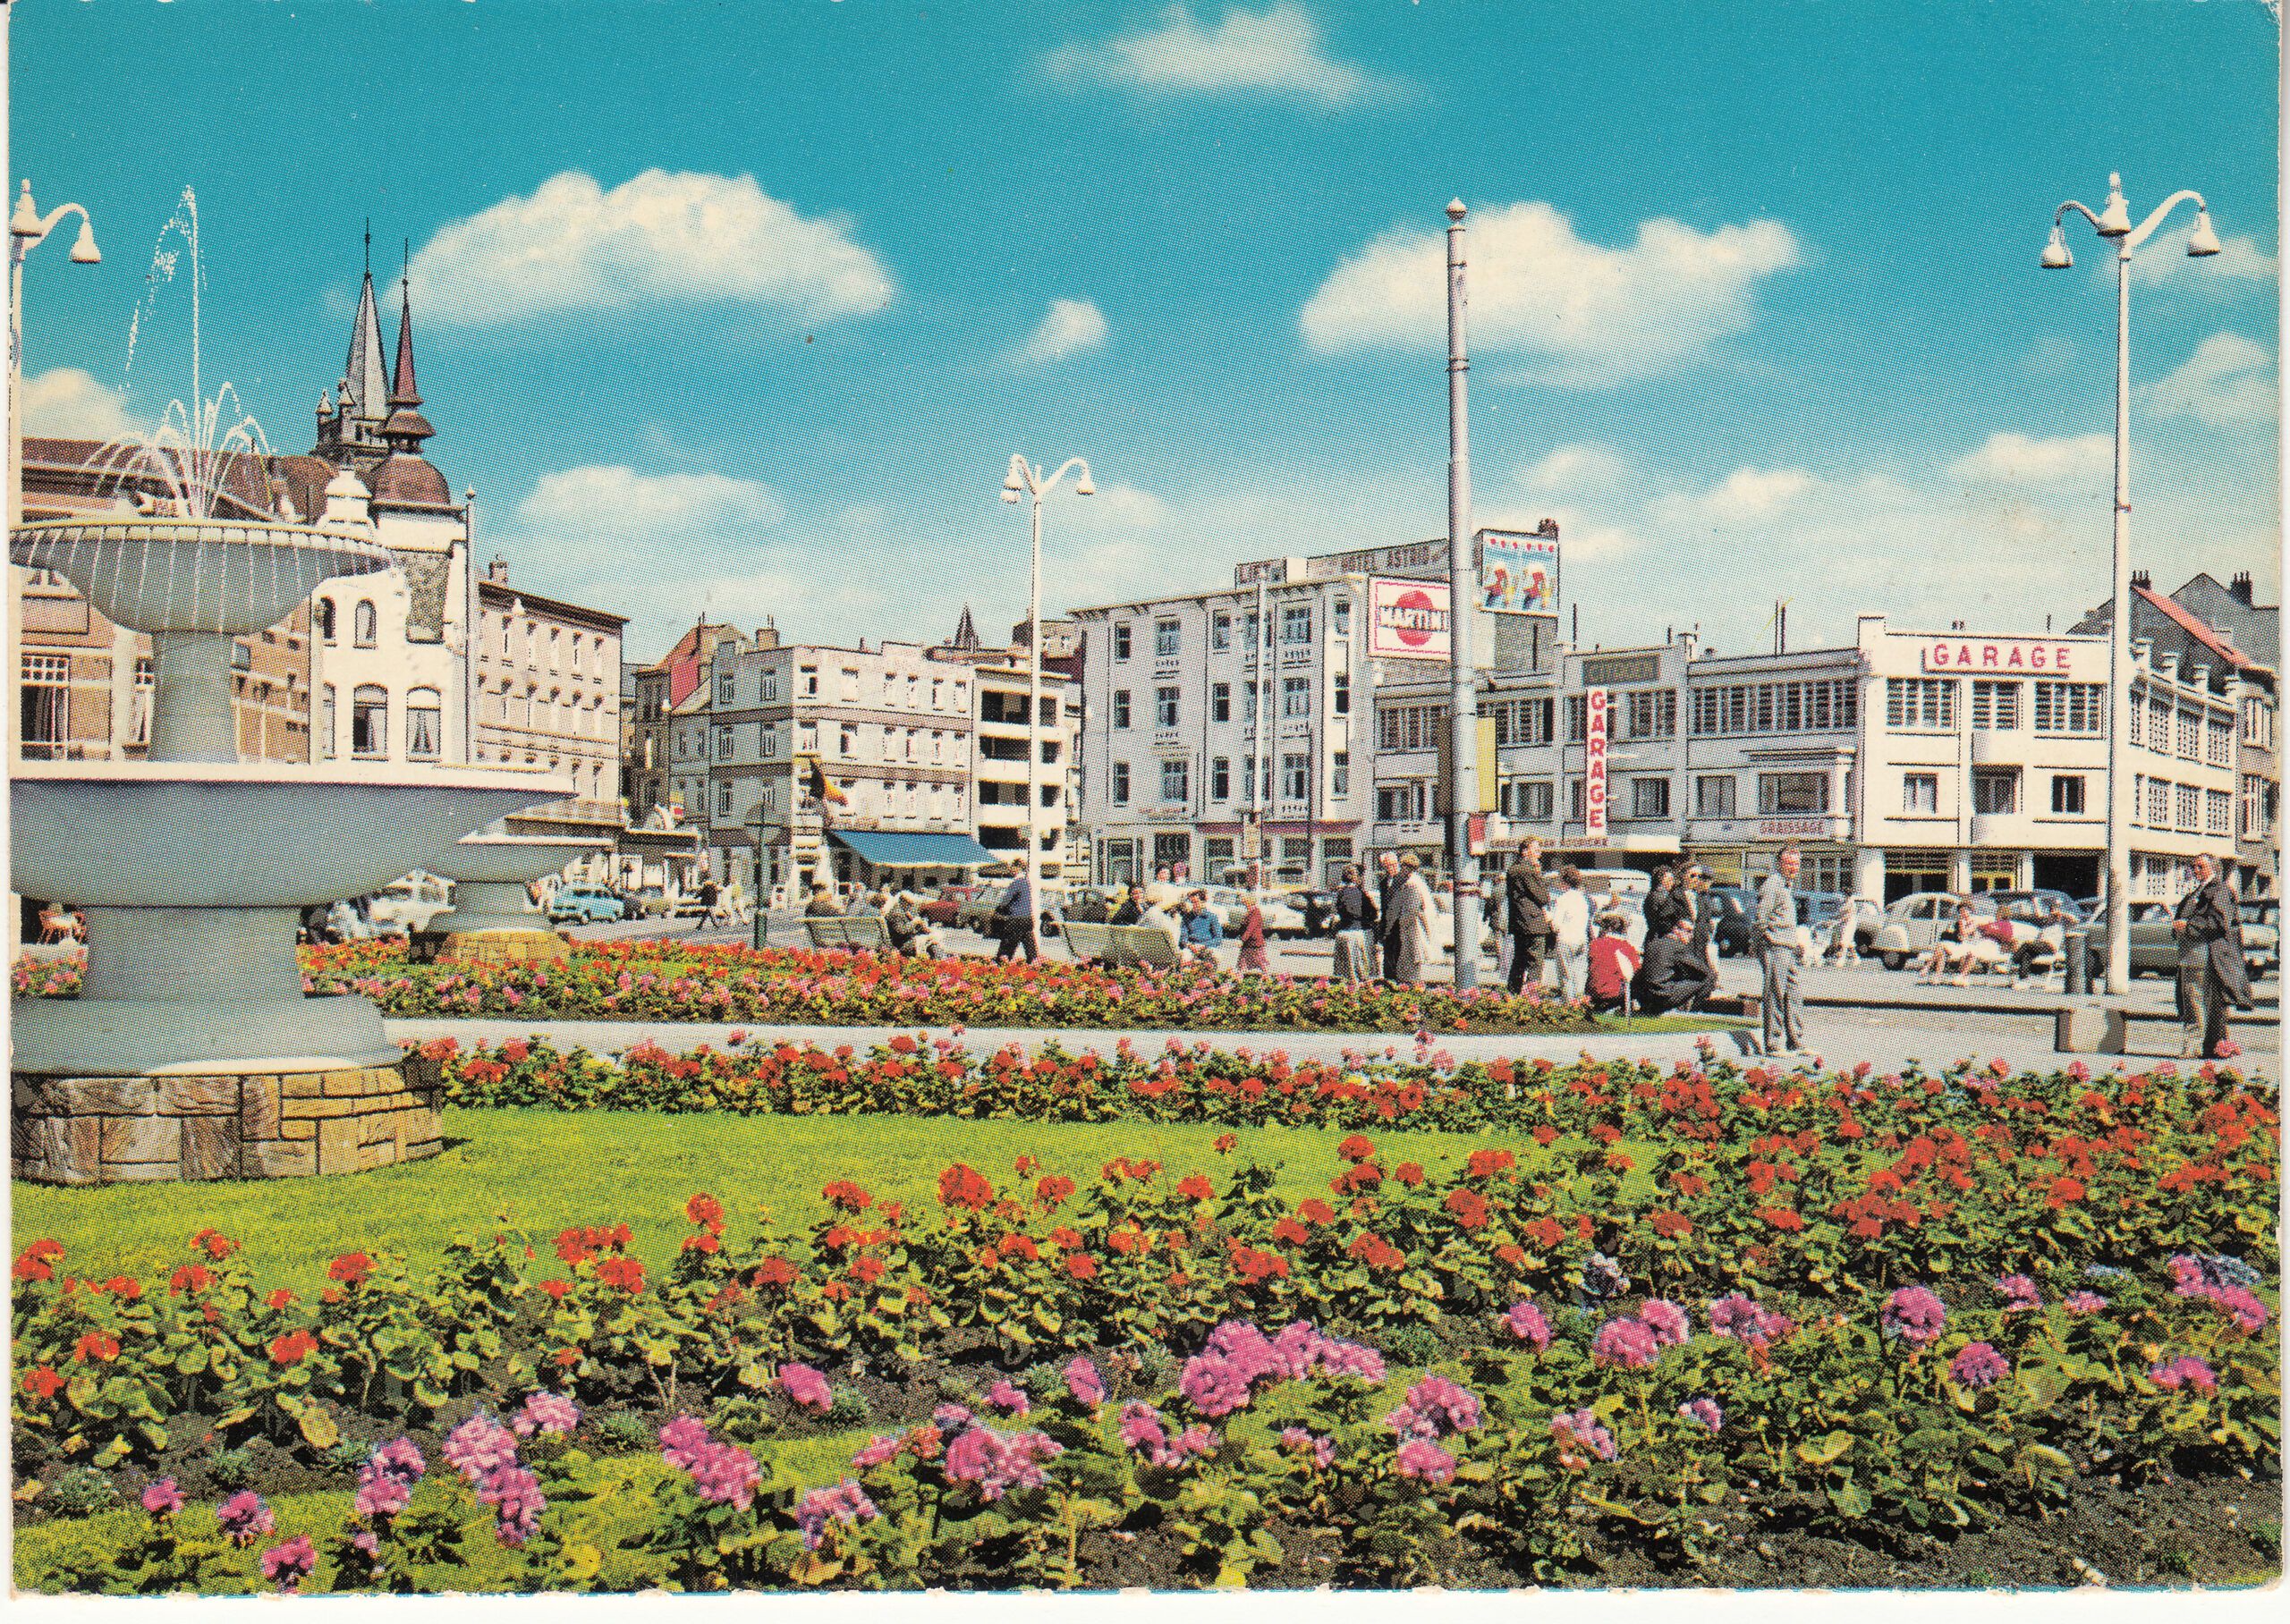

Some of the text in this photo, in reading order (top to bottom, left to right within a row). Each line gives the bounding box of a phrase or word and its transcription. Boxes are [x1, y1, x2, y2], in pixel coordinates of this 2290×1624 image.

[1341, 554, 1378, 573] HOTEL
[1387, 546, 1429, 568] ASTRID
[1378, 605, 1449, 632] MARTINI
[1933, 643, 2072, 670] GARAGE
[1590, 691, 1606, 829] GARAGE
[1760, 820, 1824, 834] GRAISSAGE
